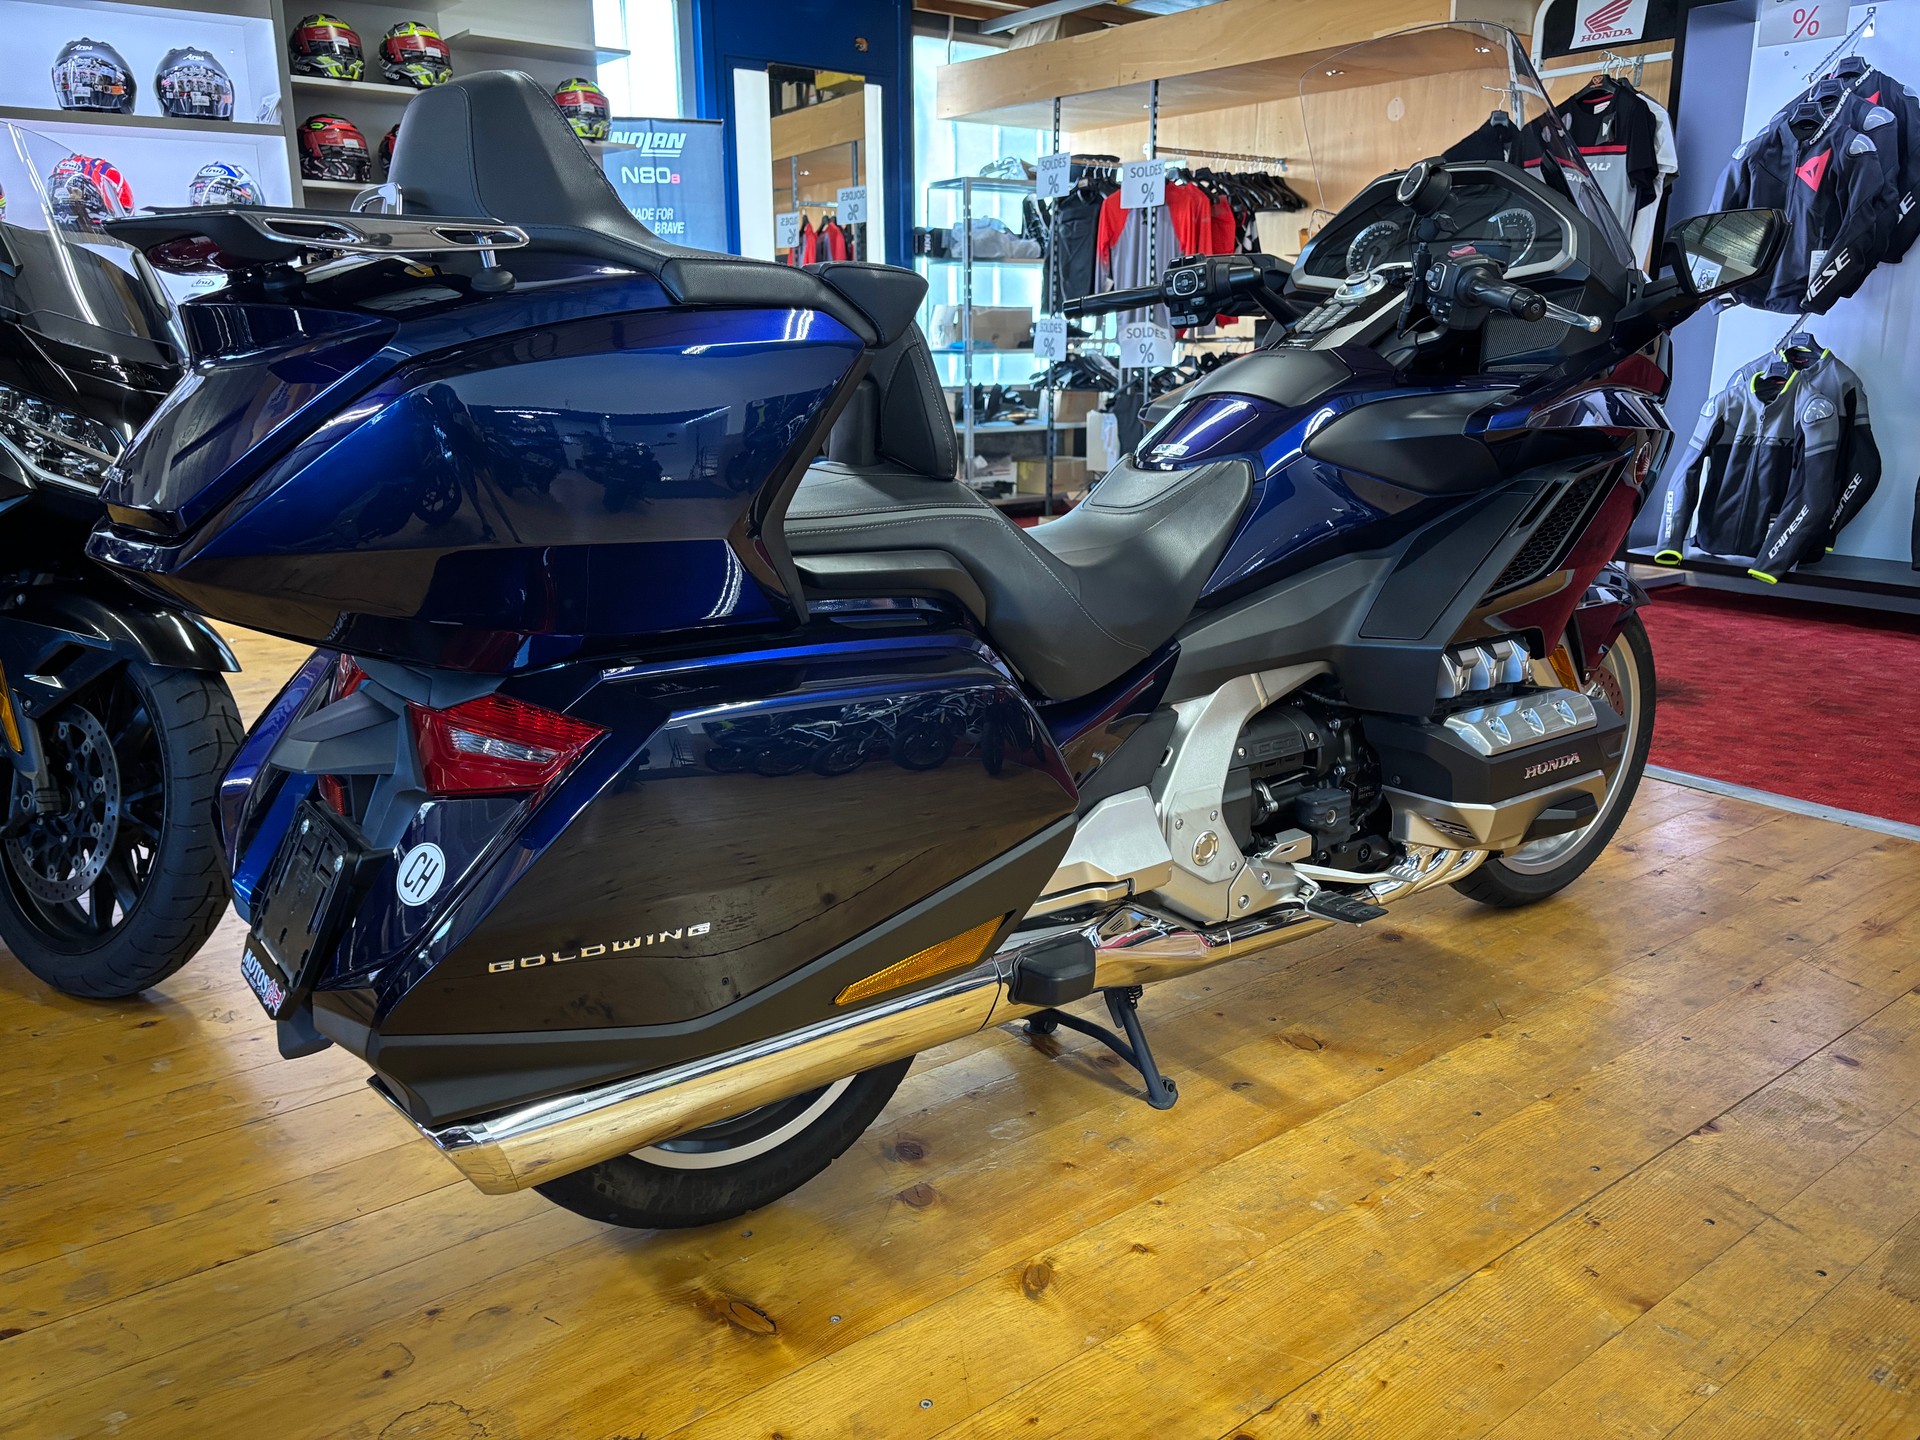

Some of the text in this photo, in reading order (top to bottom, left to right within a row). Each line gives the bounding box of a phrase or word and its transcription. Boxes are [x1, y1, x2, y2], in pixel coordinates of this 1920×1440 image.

[1580, 27, 1634, 43] HONDA
[610, 131, 687, 157] NOLAN
[1041, 156, 1067, 171] SOLDES
[1130, 164, 1162, 178] SOLDES
[655, 207, 674, 220] FOR
[654, 221, 685, 234] BRAVE
[1040, 321, 1063, 334] SOLDES
[1126, 327, 1167, 340] SOLDES
[1665, 491, 1674, 538] DAINESE
[1768, 504, 1810, 560] DAINESE
[1524, 751, 1581, 780] HONDA
[403, 851, 440, 898] CH
[488, 922, 711, 974] GOLDWING
[242, 948, 270, 993] MOTOS
